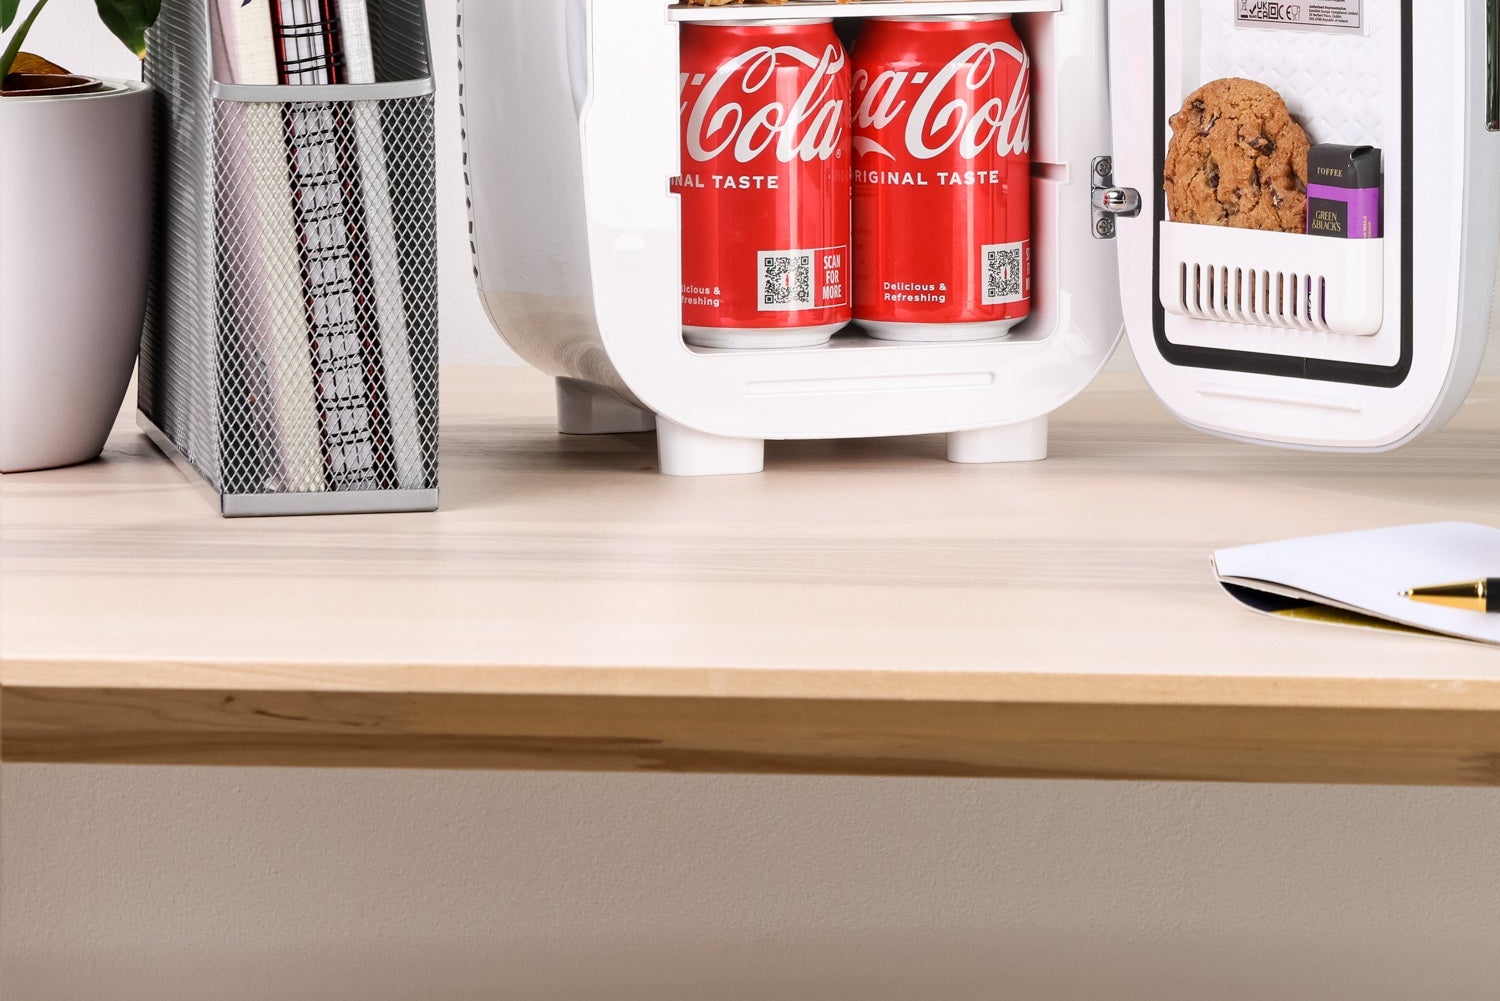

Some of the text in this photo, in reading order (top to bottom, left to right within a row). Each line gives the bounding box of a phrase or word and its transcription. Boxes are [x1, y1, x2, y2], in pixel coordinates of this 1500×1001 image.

[1256, 1, 1268, 10] UK
[1256, 10, 1268, 19] CA
[711, 174, 779, 189] TASTE
[853, 169, 1000, 186] RIGINAL TASTE
[1315, 210, 1337, 221] GREEN
[823, 254, 841, 270] SCAN
[825, 270, 839, 284] FOR
[713, 286, 721, 295] &
[822, 284, 842, 300] MORE
[883, 281, 947, 291] Delicious &
[884, 292, 946, 304] Refreshing
